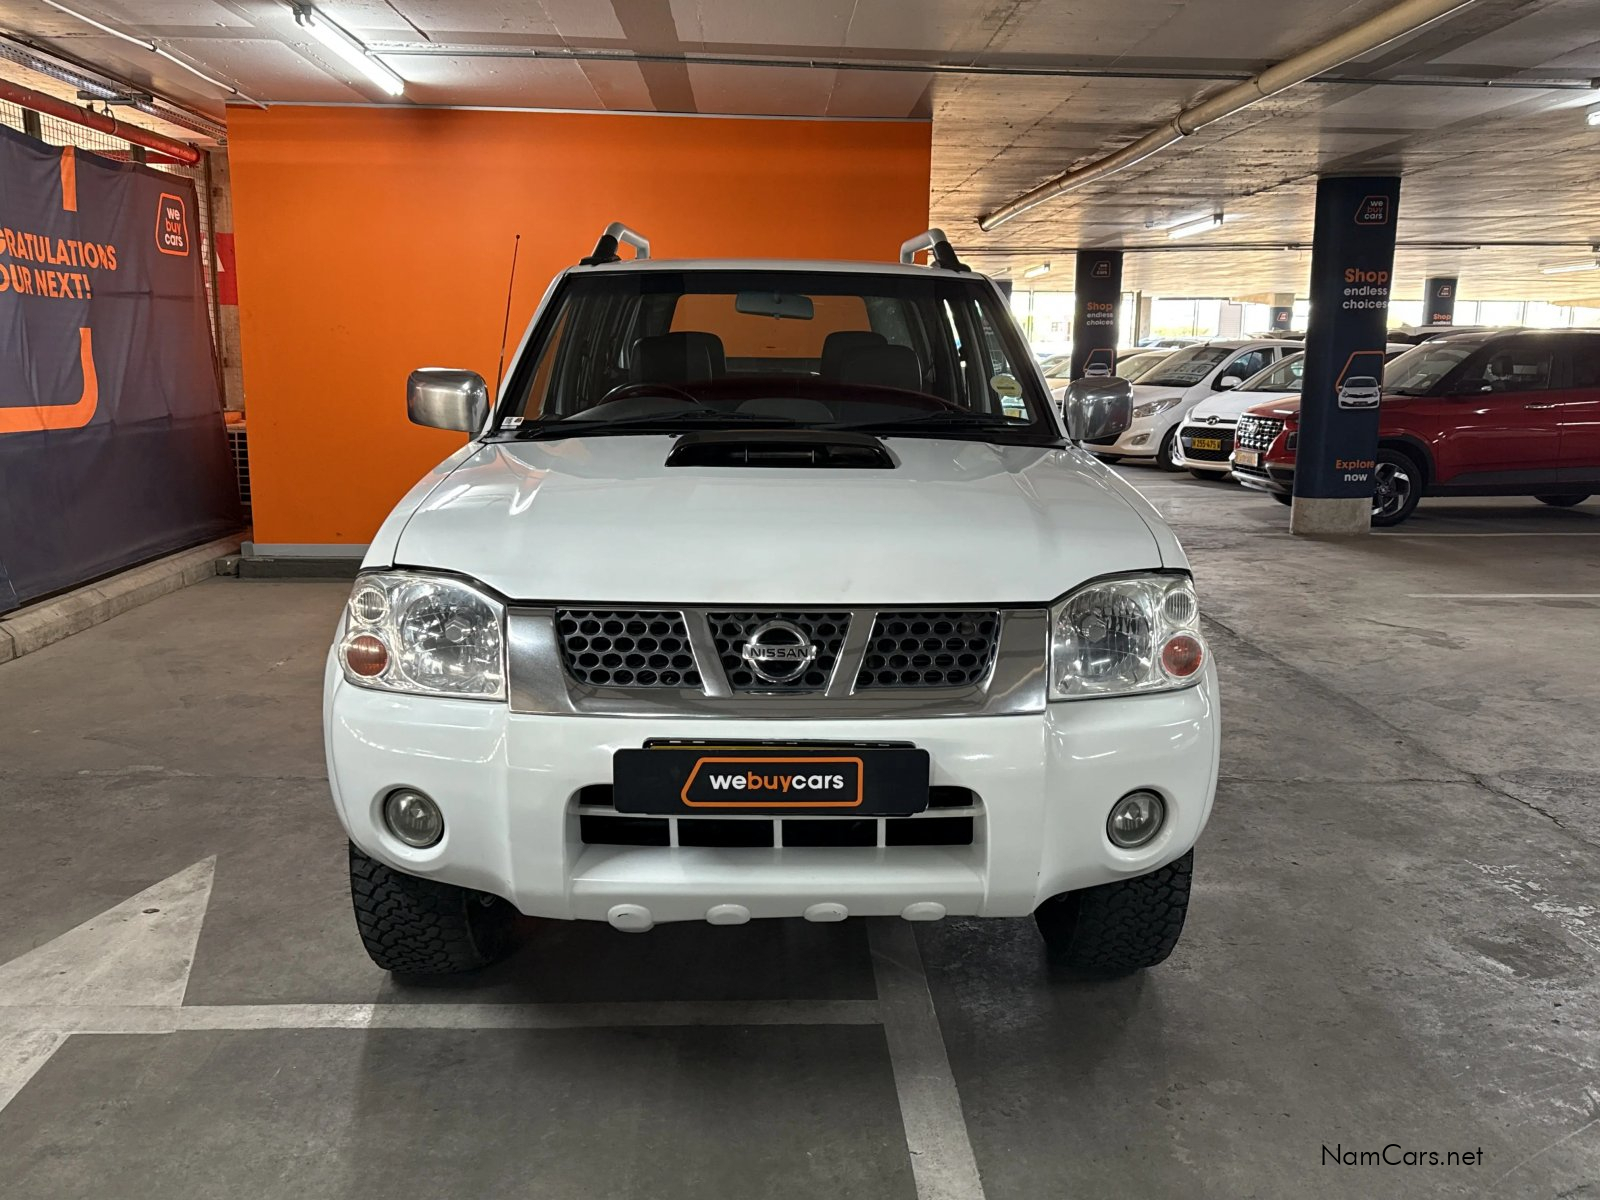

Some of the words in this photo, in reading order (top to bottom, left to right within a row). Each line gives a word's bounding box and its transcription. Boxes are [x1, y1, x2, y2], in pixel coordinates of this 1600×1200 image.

[166, 207, 181, 220] we
[1367, 206, 1383, 214] buy
[165, 218, 181, 236] buy
[164, 233, 184, 247] cars
[1344, 268, 1388, 285] Shop
[34, 268, 92, 300] NEXT!
[1343, 286, 1388, 296] endless
[1087, 302, 1113, 311] Shop
[1342, 299, 1389, 309] choices
[1433, 313, 1452, 321] Shop
[1335, 460, 1375, 470] Explore
[1344, 473, 1368, 482] now
[750, 648, 808, 658] NISSAN
[709, 771, 845, 793] webuycars
